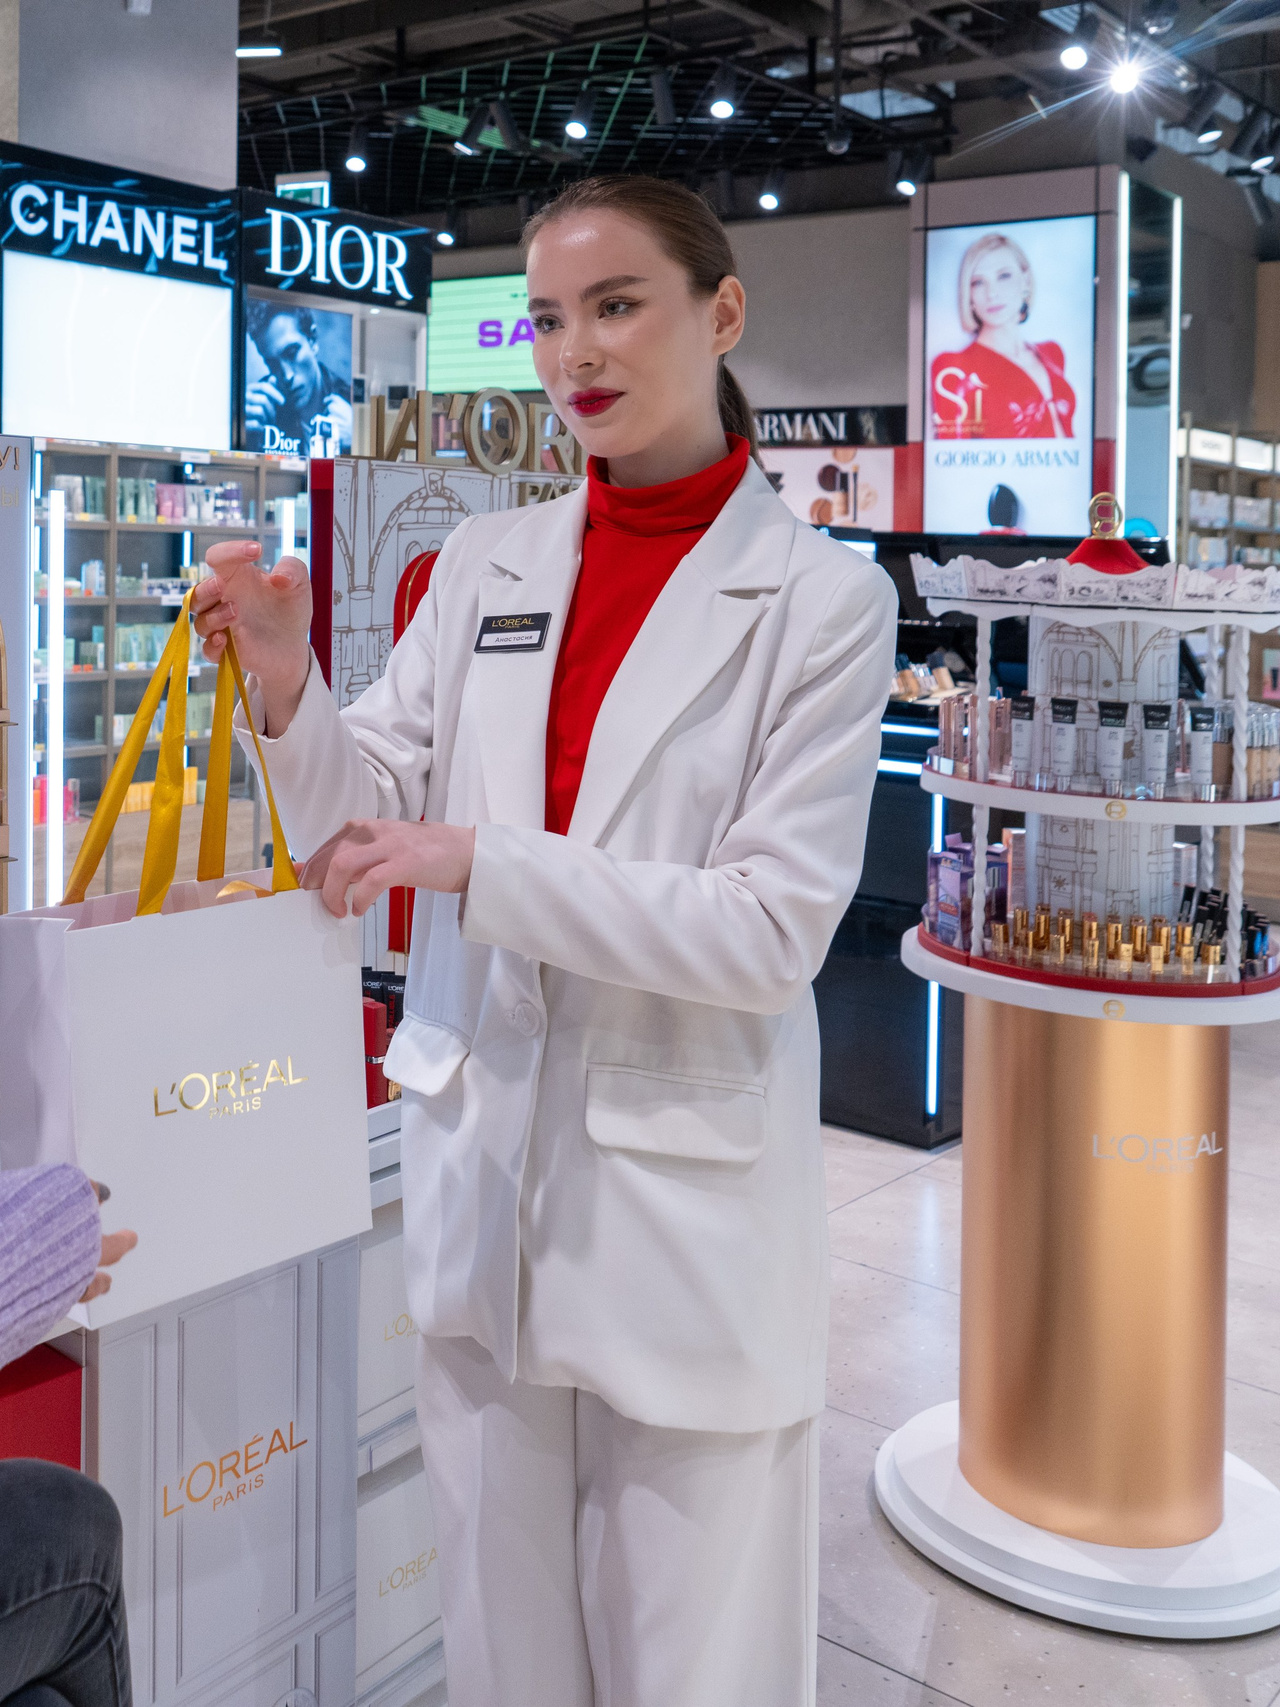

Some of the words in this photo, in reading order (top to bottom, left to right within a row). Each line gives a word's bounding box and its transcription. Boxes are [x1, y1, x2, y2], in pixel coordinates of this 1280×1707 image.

[10, 183, 228, 271] CHANEL
[265, 207, 413, 300] DIOR
[263, 425, 300, 451] Dior
[935, 450, 1006, 467] GIORGIO
[1013, 449, 1080, 467] ARMANI
[492, 618, 535, 628] L'ORÉAL
[153, 1056, 309, 1117] L'ORÉAL
[1092, 1131, 1223, 1163] L'ORÉAL
[163, 1421, 308, 1518] L'ORÉAL
